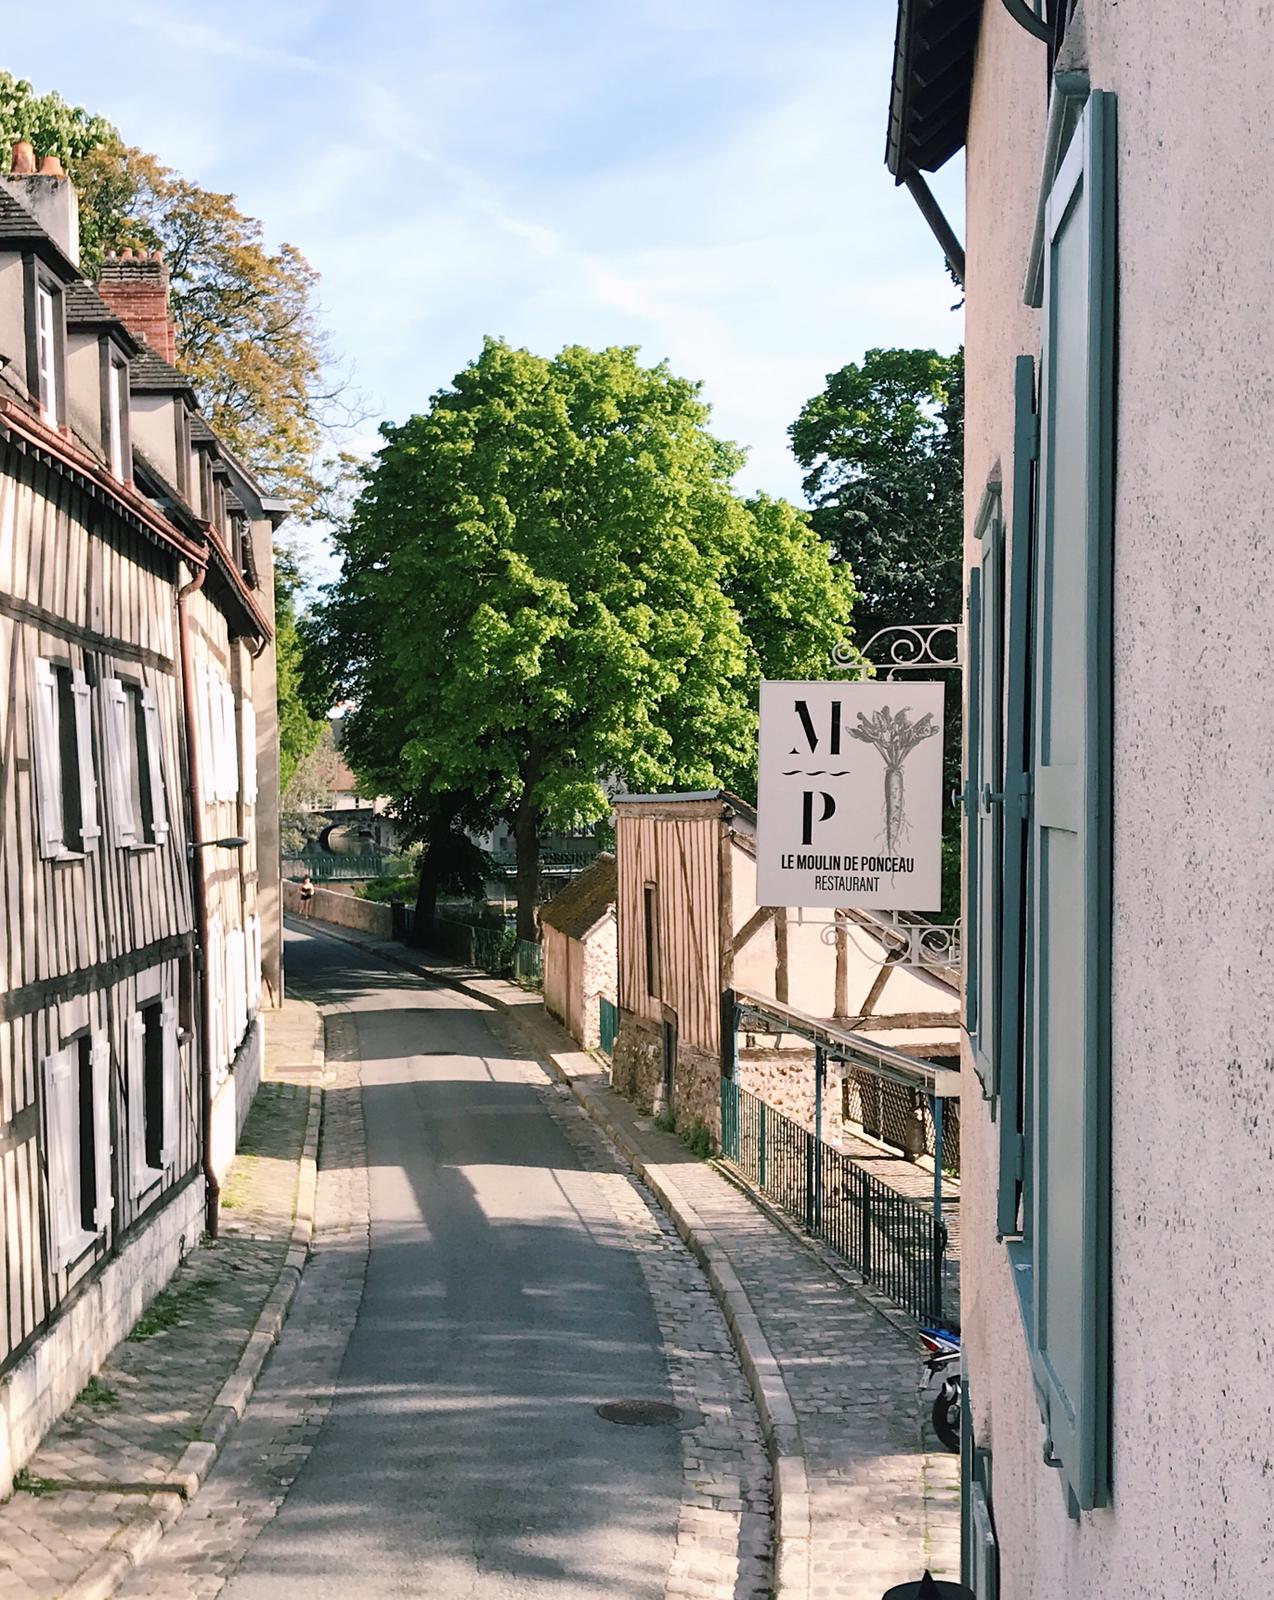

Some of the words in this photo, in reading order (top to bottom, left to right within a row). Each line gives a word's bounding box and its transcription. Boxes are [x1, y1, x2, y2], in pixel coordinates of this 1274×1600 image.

[788, 700, 842, 755] M
[801, 791, 836, 846] P
[781, 854, 795, 870] LE
[797, 854, 841, 871] MOULIN
[844, 856, 859, 872] DE
[861, 856, 914, 873] PONCEAU
[815, 875, 880, 892] RESTAURANT
